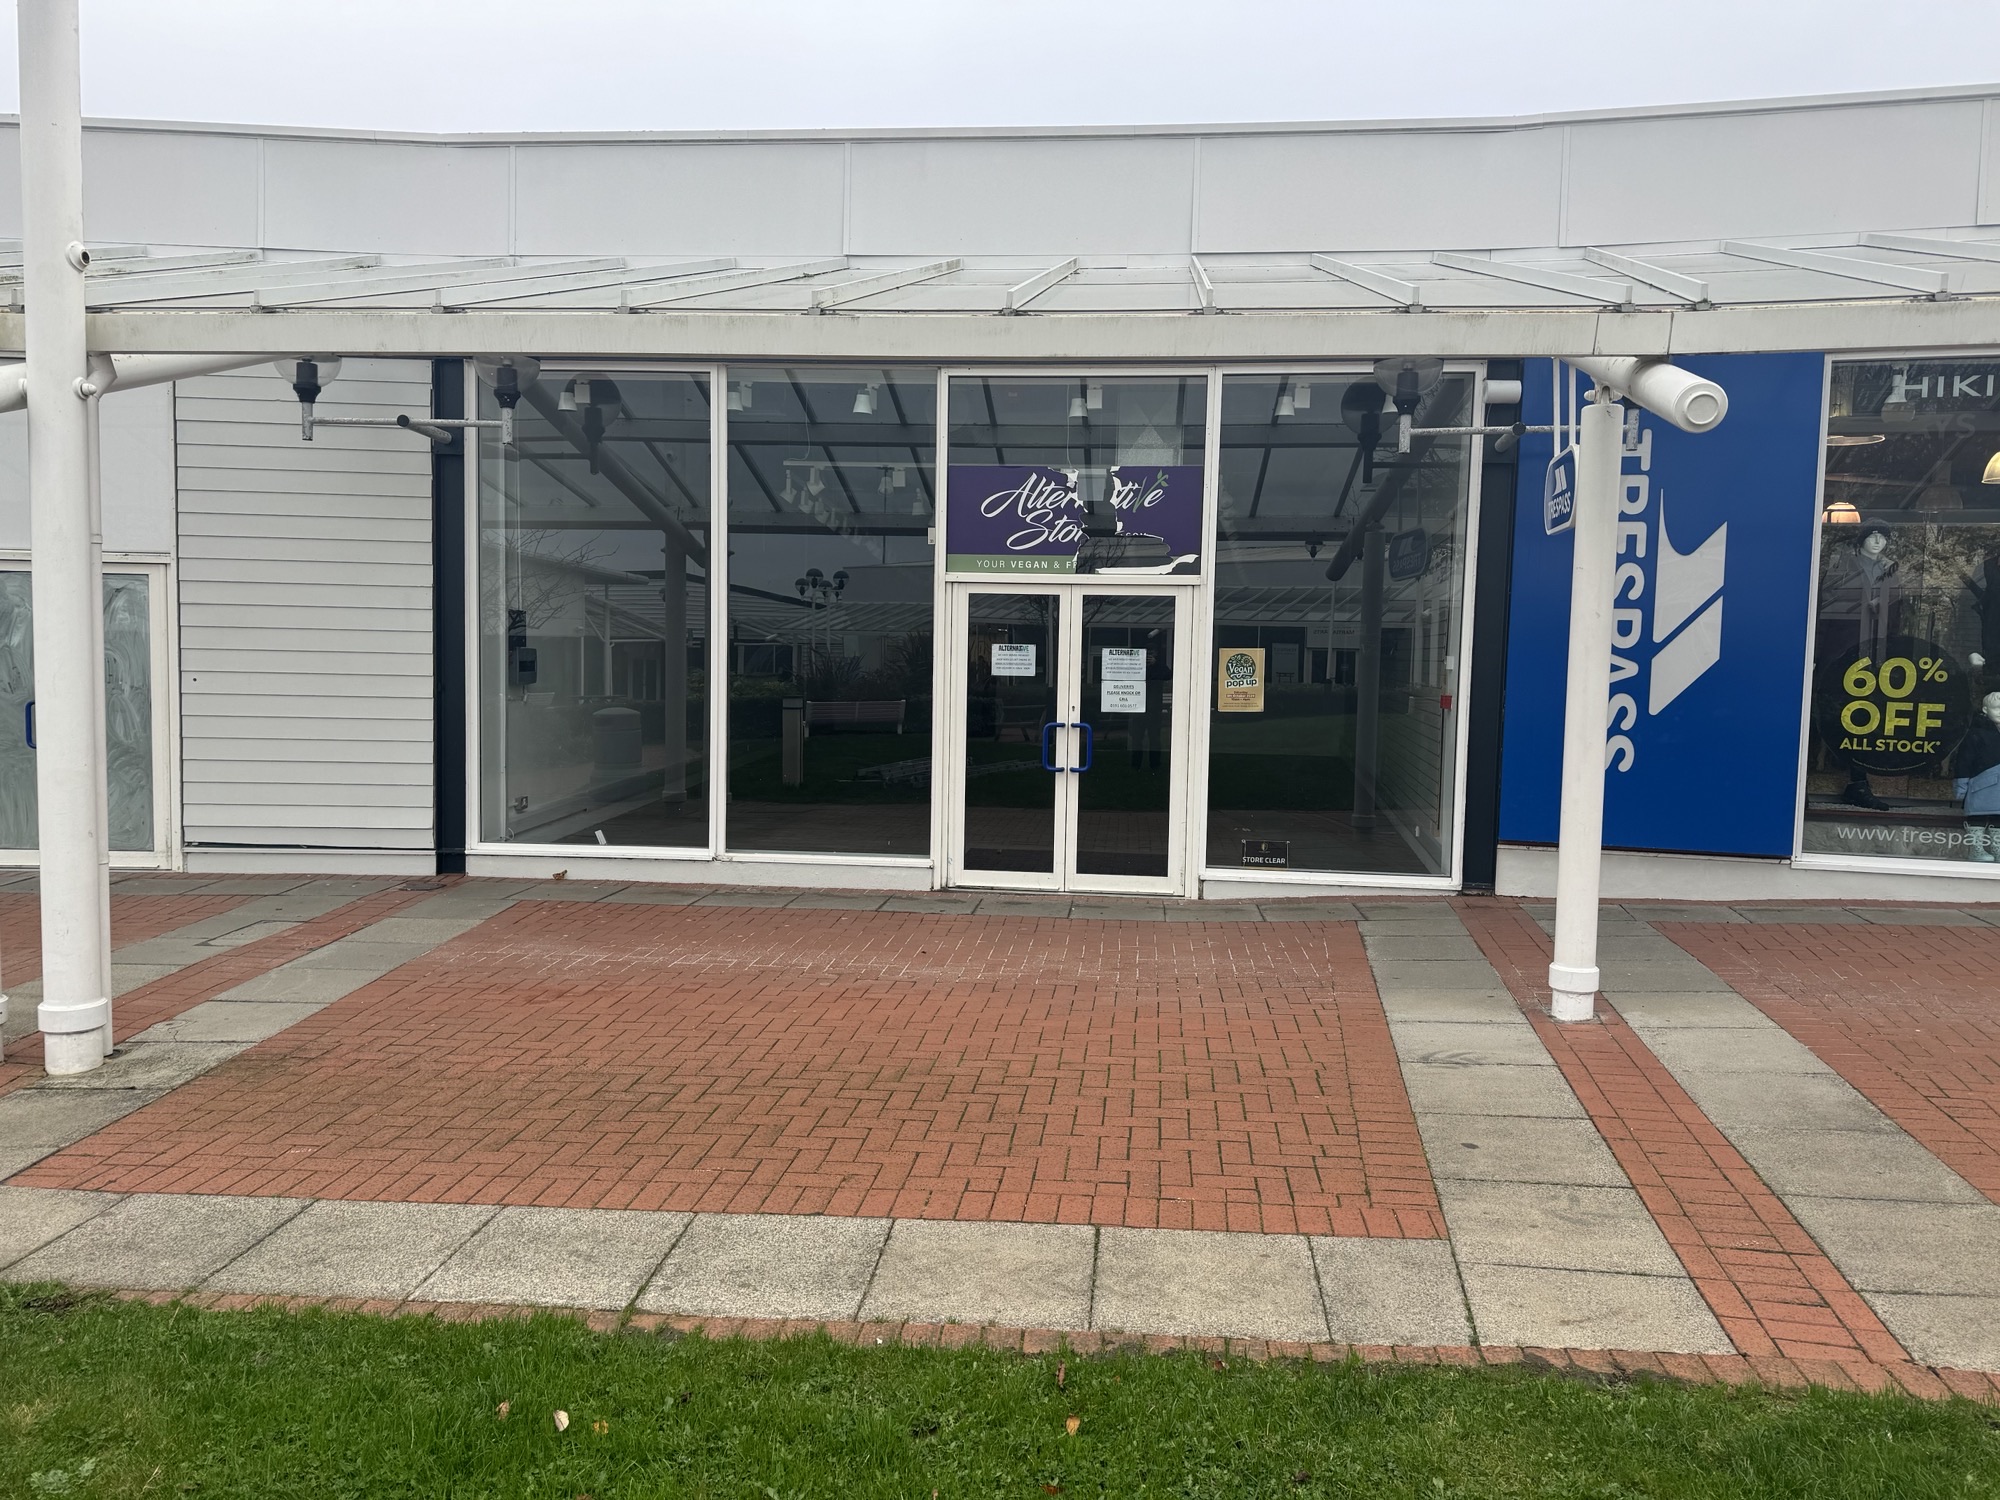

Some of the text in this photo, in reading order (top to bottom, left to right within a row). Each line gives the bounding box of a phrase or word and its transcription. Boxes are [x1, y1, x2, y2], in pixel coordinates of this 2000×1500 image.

[1548, 491, 1571, 520] TRESPASS
[977, 560, 1005, 568] YOUR
[1011, 560, 1048, 569] VEGAN
[1053, 561, 1060, 569] &
[1226, 680, 1244, 688] pop
[1843, 656, 1948, 699] 60%
[1840, 700, 1946, 738] OFF
[1839, 737, 1872, 751] ALL
